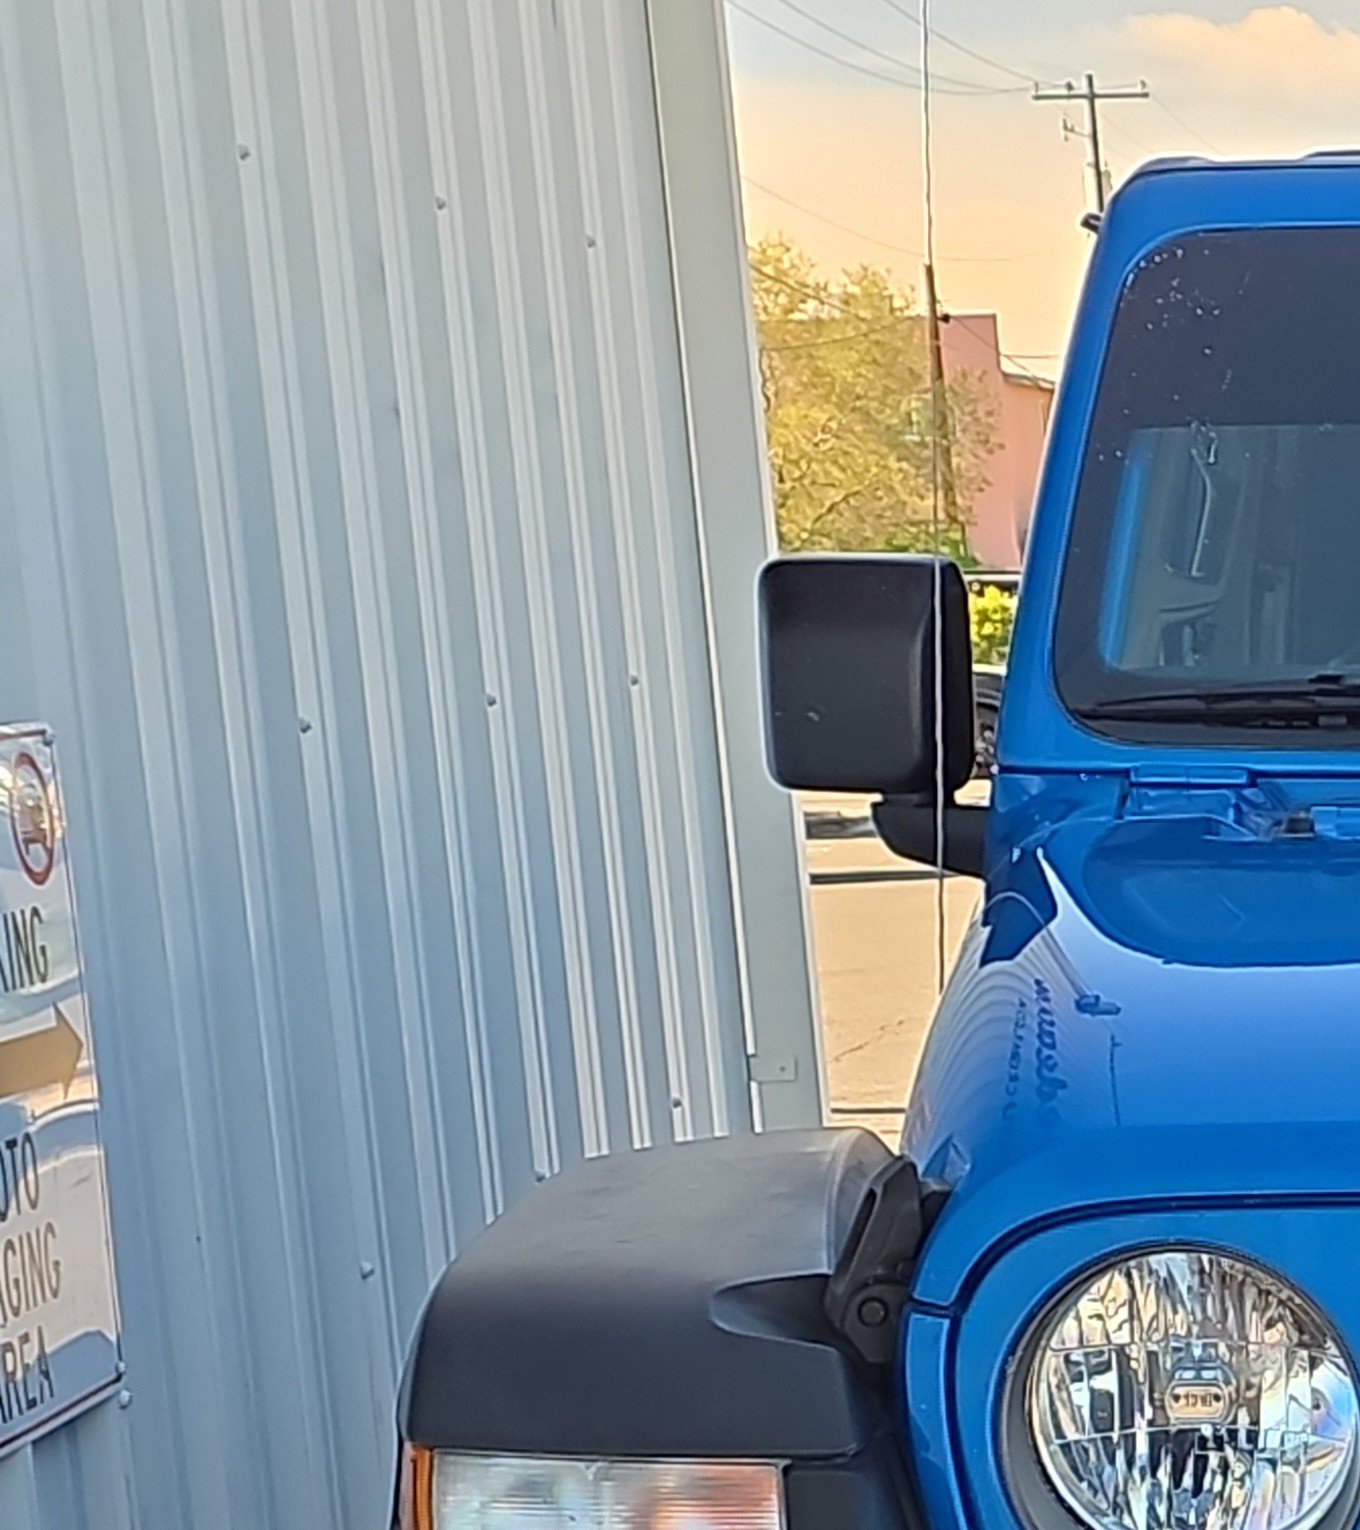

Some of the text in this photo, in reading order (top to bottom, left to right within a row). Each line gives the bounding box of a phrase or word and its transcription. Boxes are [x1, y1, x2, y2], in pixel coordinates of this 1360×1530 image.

[0, 906, 48, 993] ING
[0, 1222, 60, 1328] GING
[0, 1325, 54, 1424] REA
